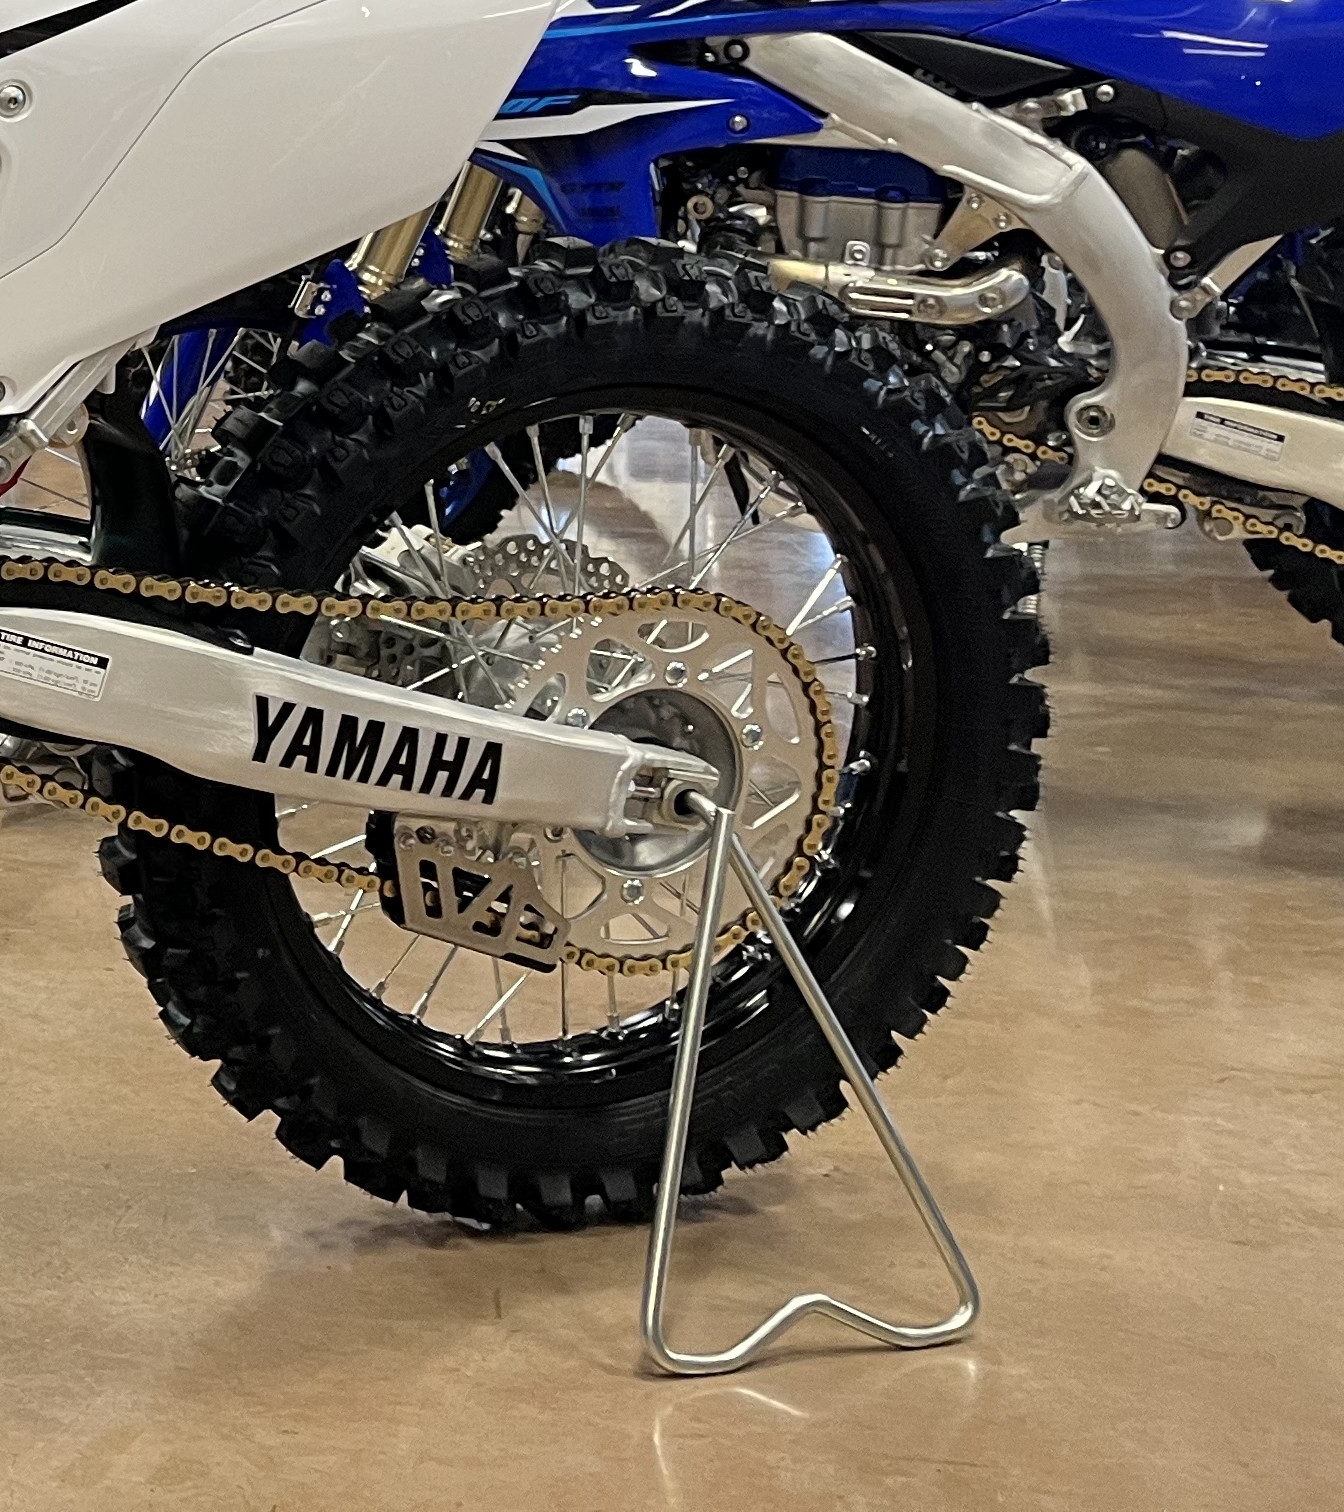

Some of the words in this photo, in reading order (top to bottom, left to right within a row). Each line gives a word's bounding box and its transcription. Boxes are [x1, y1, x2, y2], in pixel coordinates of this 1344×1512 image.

[0, 631, 25, 645] TIRE
[27, 639, 100, 665] INFORMATION
[252, 694, 503, 805] YAMAHA
